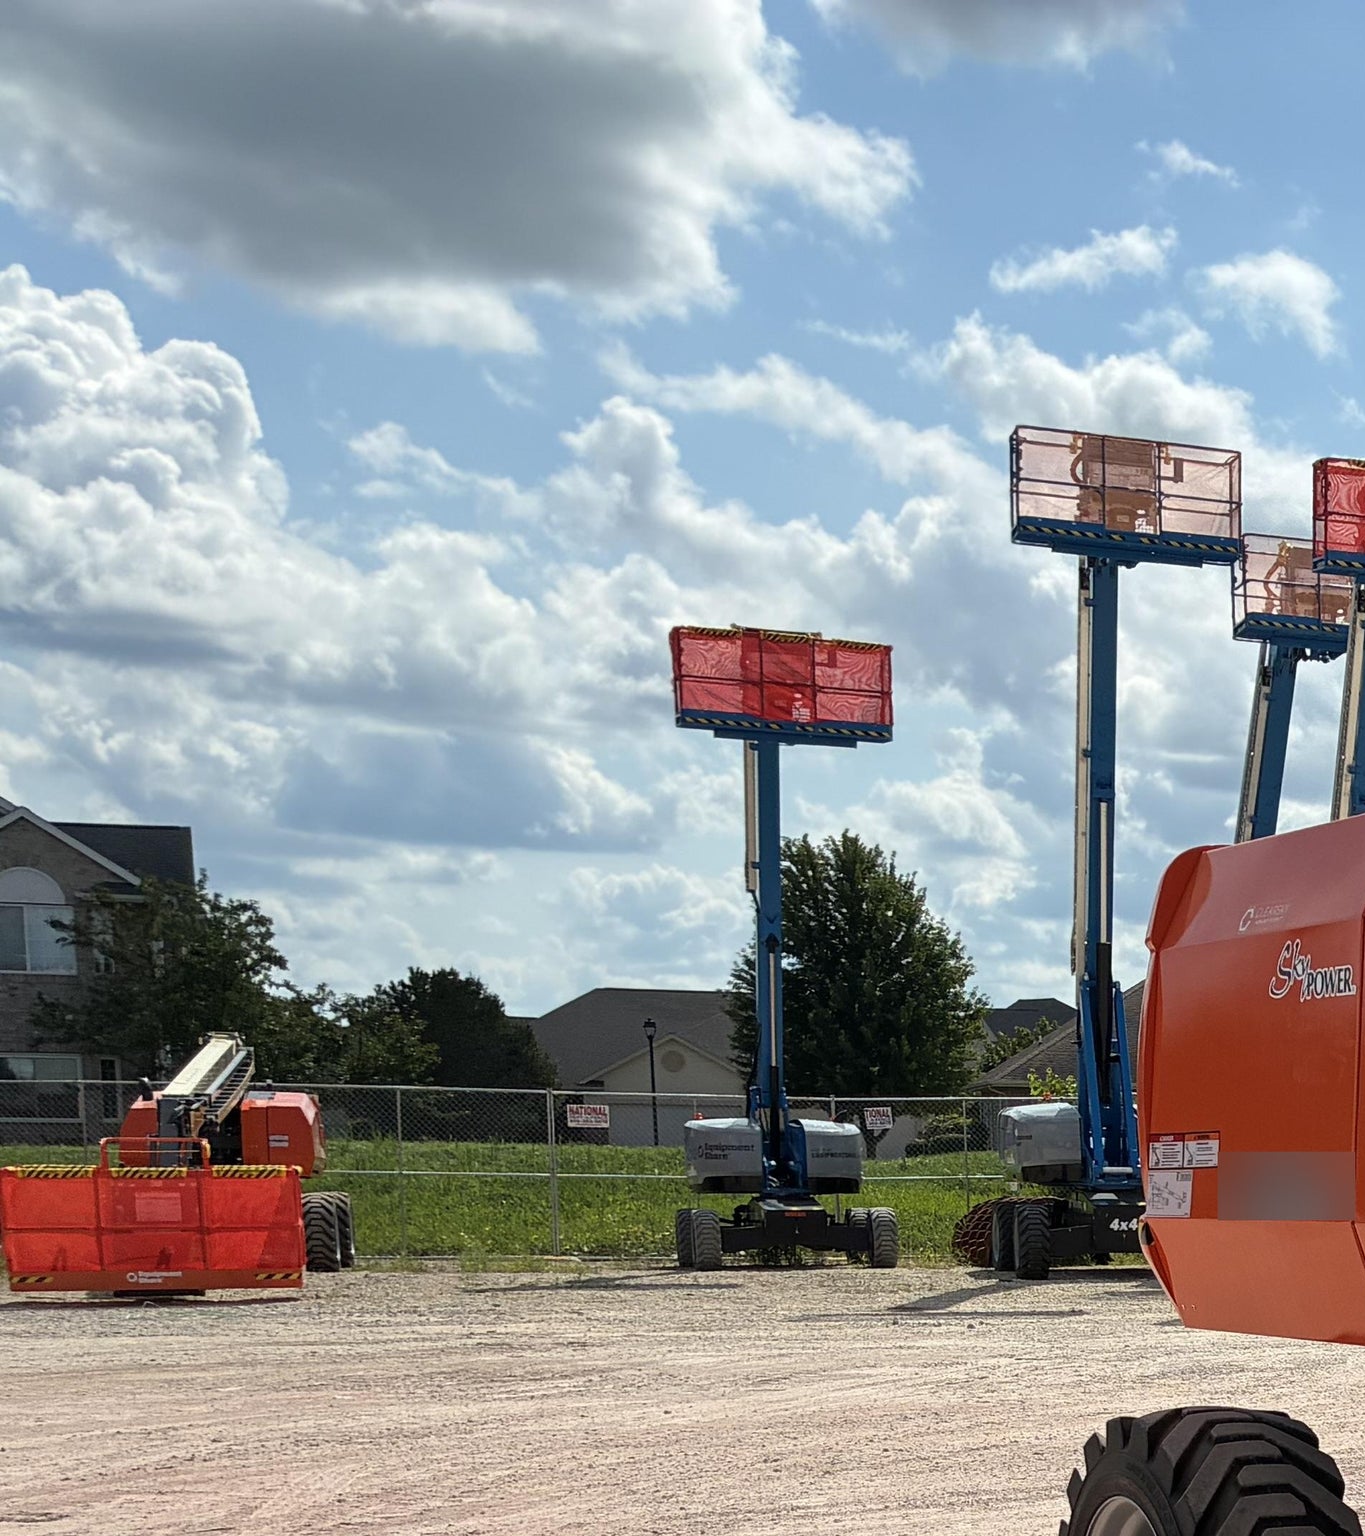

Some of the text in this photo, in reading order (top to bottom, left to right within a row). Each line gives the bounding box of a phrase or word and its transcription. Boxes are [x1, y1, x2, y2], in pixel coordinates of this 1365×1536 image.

[1304, 966, 1352, 999] POWER
[569, 1105, 607, 1116] NATIONAL
[1109, 1218, 1138, 1231] 4x4
